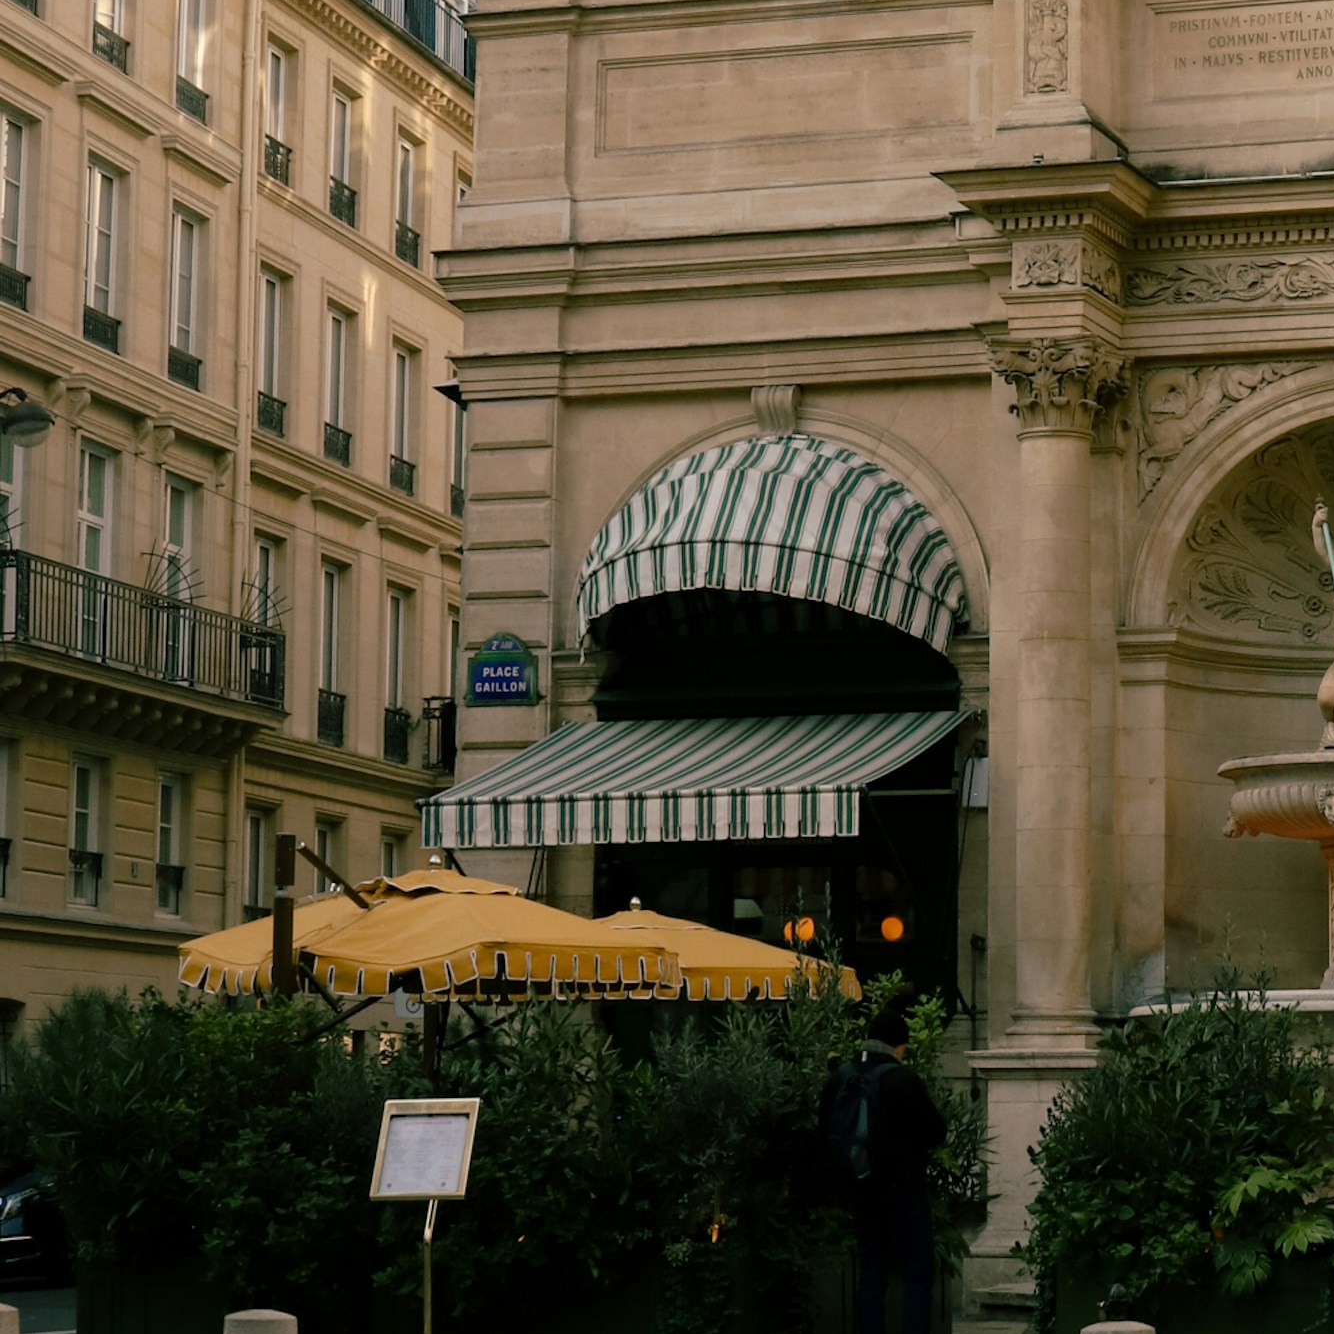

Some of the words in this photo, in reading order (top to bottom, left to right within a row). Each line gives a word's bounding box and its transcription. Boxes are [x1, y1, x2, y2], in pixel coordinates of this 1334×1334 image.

[1169, 15, 1241, 34] PRISTINVM
[1249, 11, 1304, 28] FONTEM
[1207, 32, 1270, 50] COMMVNI
[1173, 56, 1188, 71] IN
[1201, 53, 1245, 69] MAJVS
[1296, 64, 1334, 80] ANNO
[483, 667, 519, 677] PLACE
[475, 682, 526, 693] GAILLON
